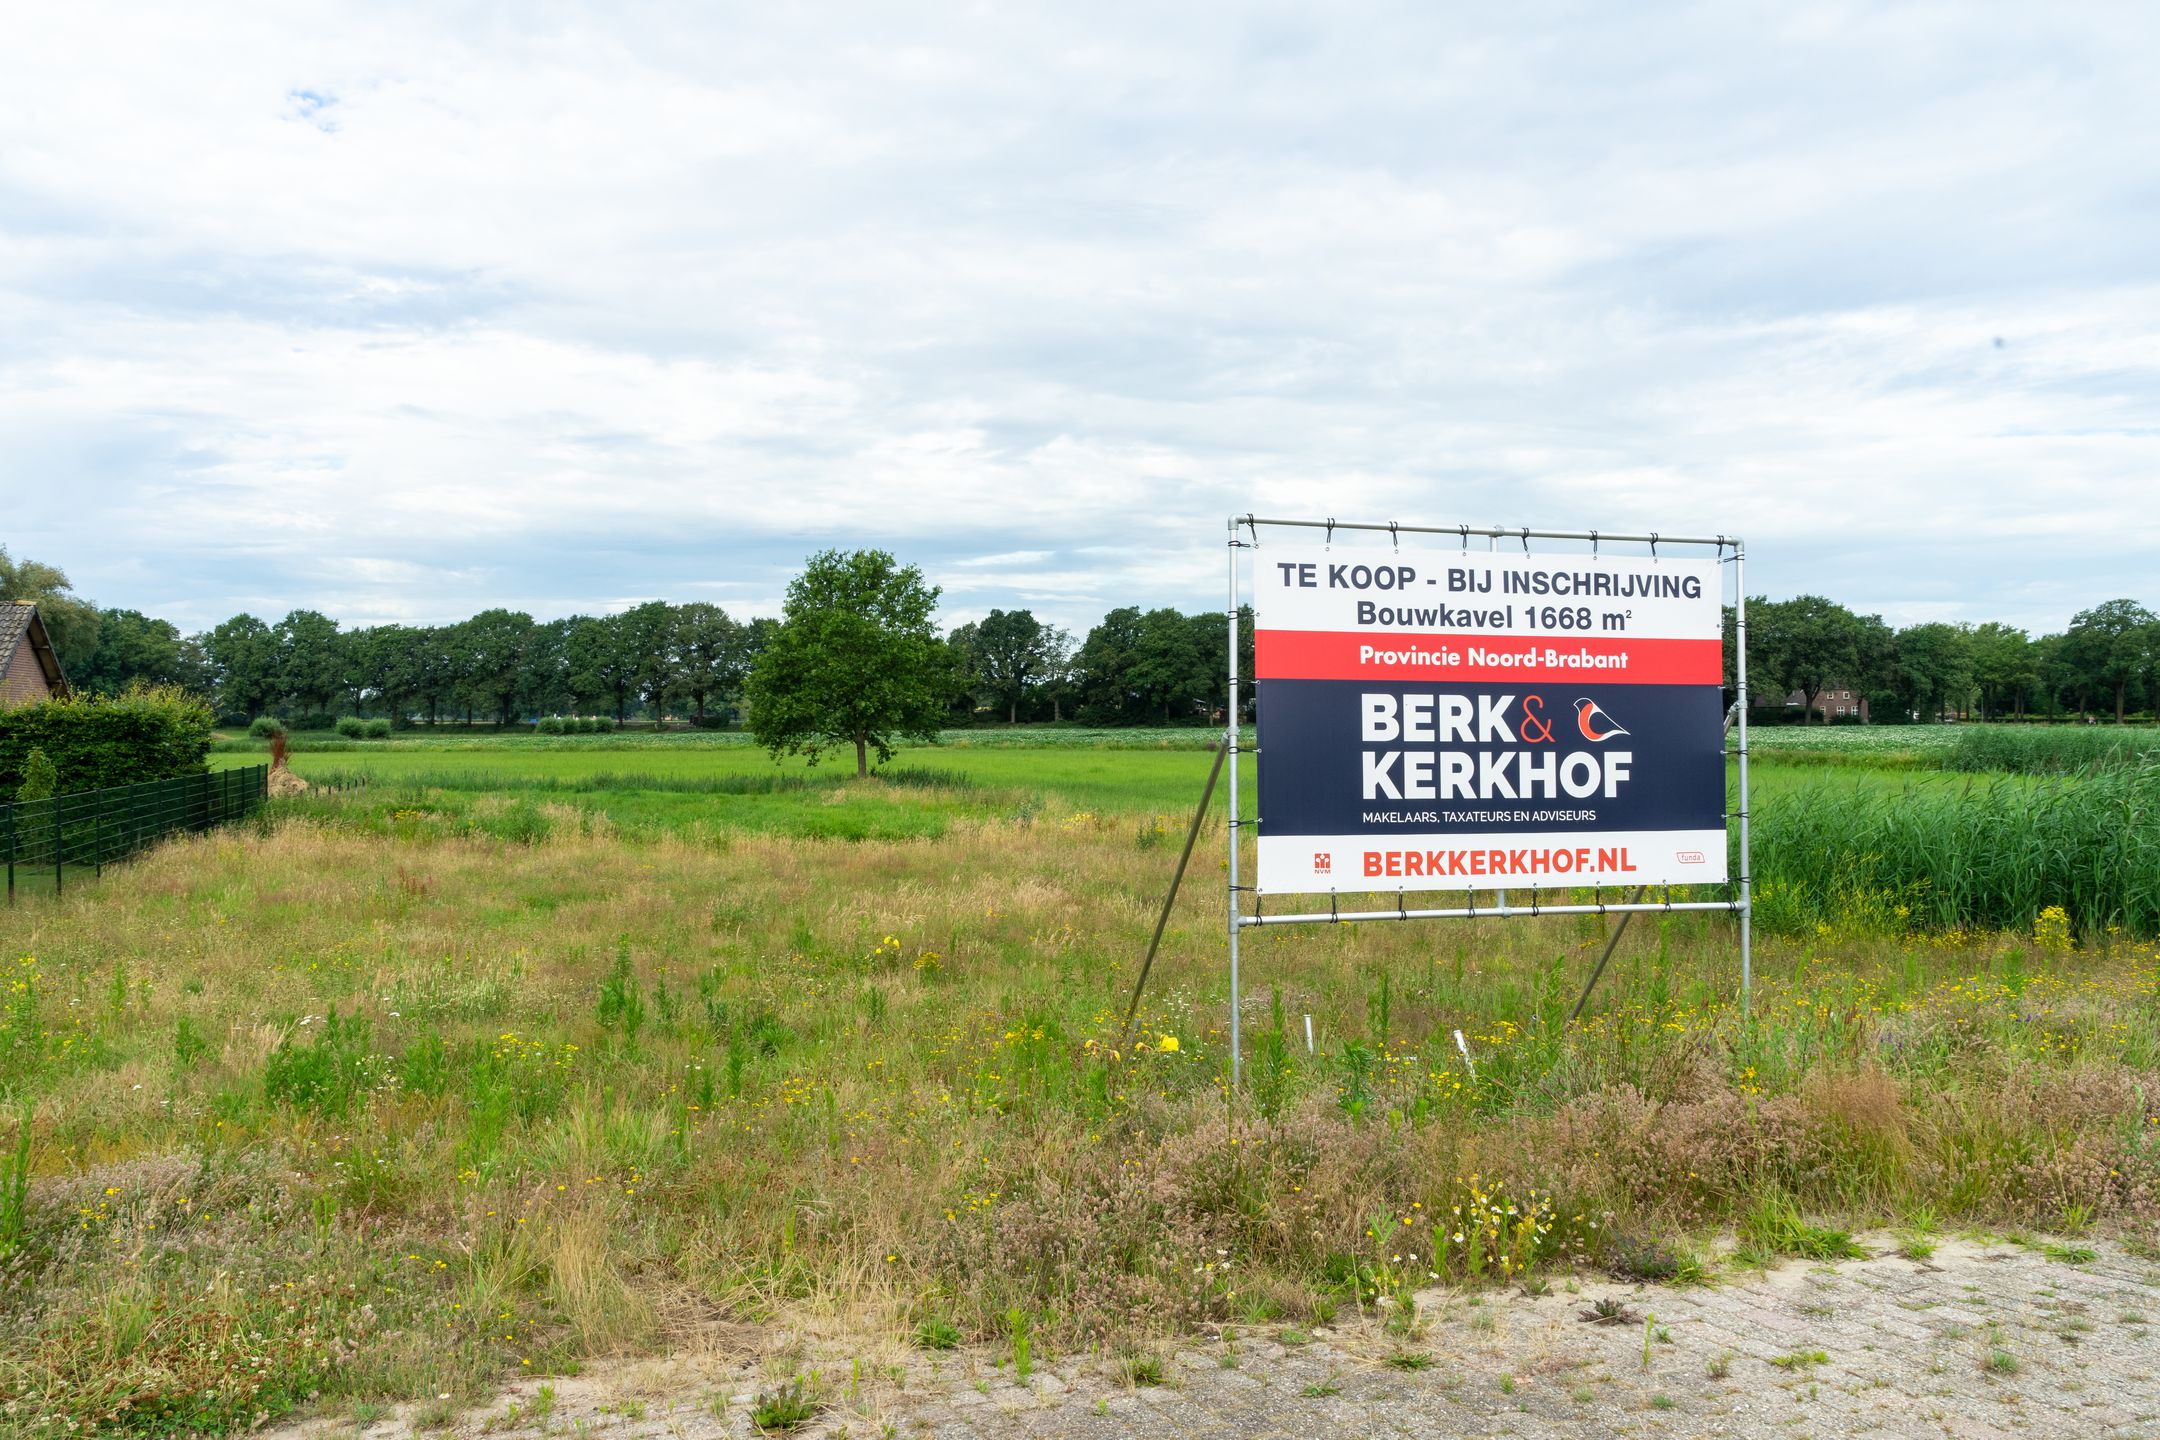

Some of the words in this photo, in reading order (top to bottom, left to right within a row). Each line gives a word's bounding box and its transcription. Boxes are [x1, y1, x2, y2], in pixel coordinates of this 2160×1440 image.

[1277, 562, 1317, 588] TE
[1328, 564, 1416, 590] KOOP
[1448, 568, 1492, 593] BIJ
[1503, 570, 1701, 599] INSCHRIJVING
[1357, 600, 1512, 629] Bouwkavel
[1525, 605, 1592, 630] 1668
[1360, 645, 1461, 666] Provincie
[1467, 647, 1628, 669] Noord-Brabant
[1362, 751, 1633, 800] KERKHOF
[1362, 811, 1440, 823] MAKELAARS,
[1442, 811, 1512, 823] TAXATEURS
[1513, 811, 1530, 822] EN
[1532, 810, 1596, 822] ADVISEURS
[1363, 847, 1637, 877] BERKKERKHOF.NL
